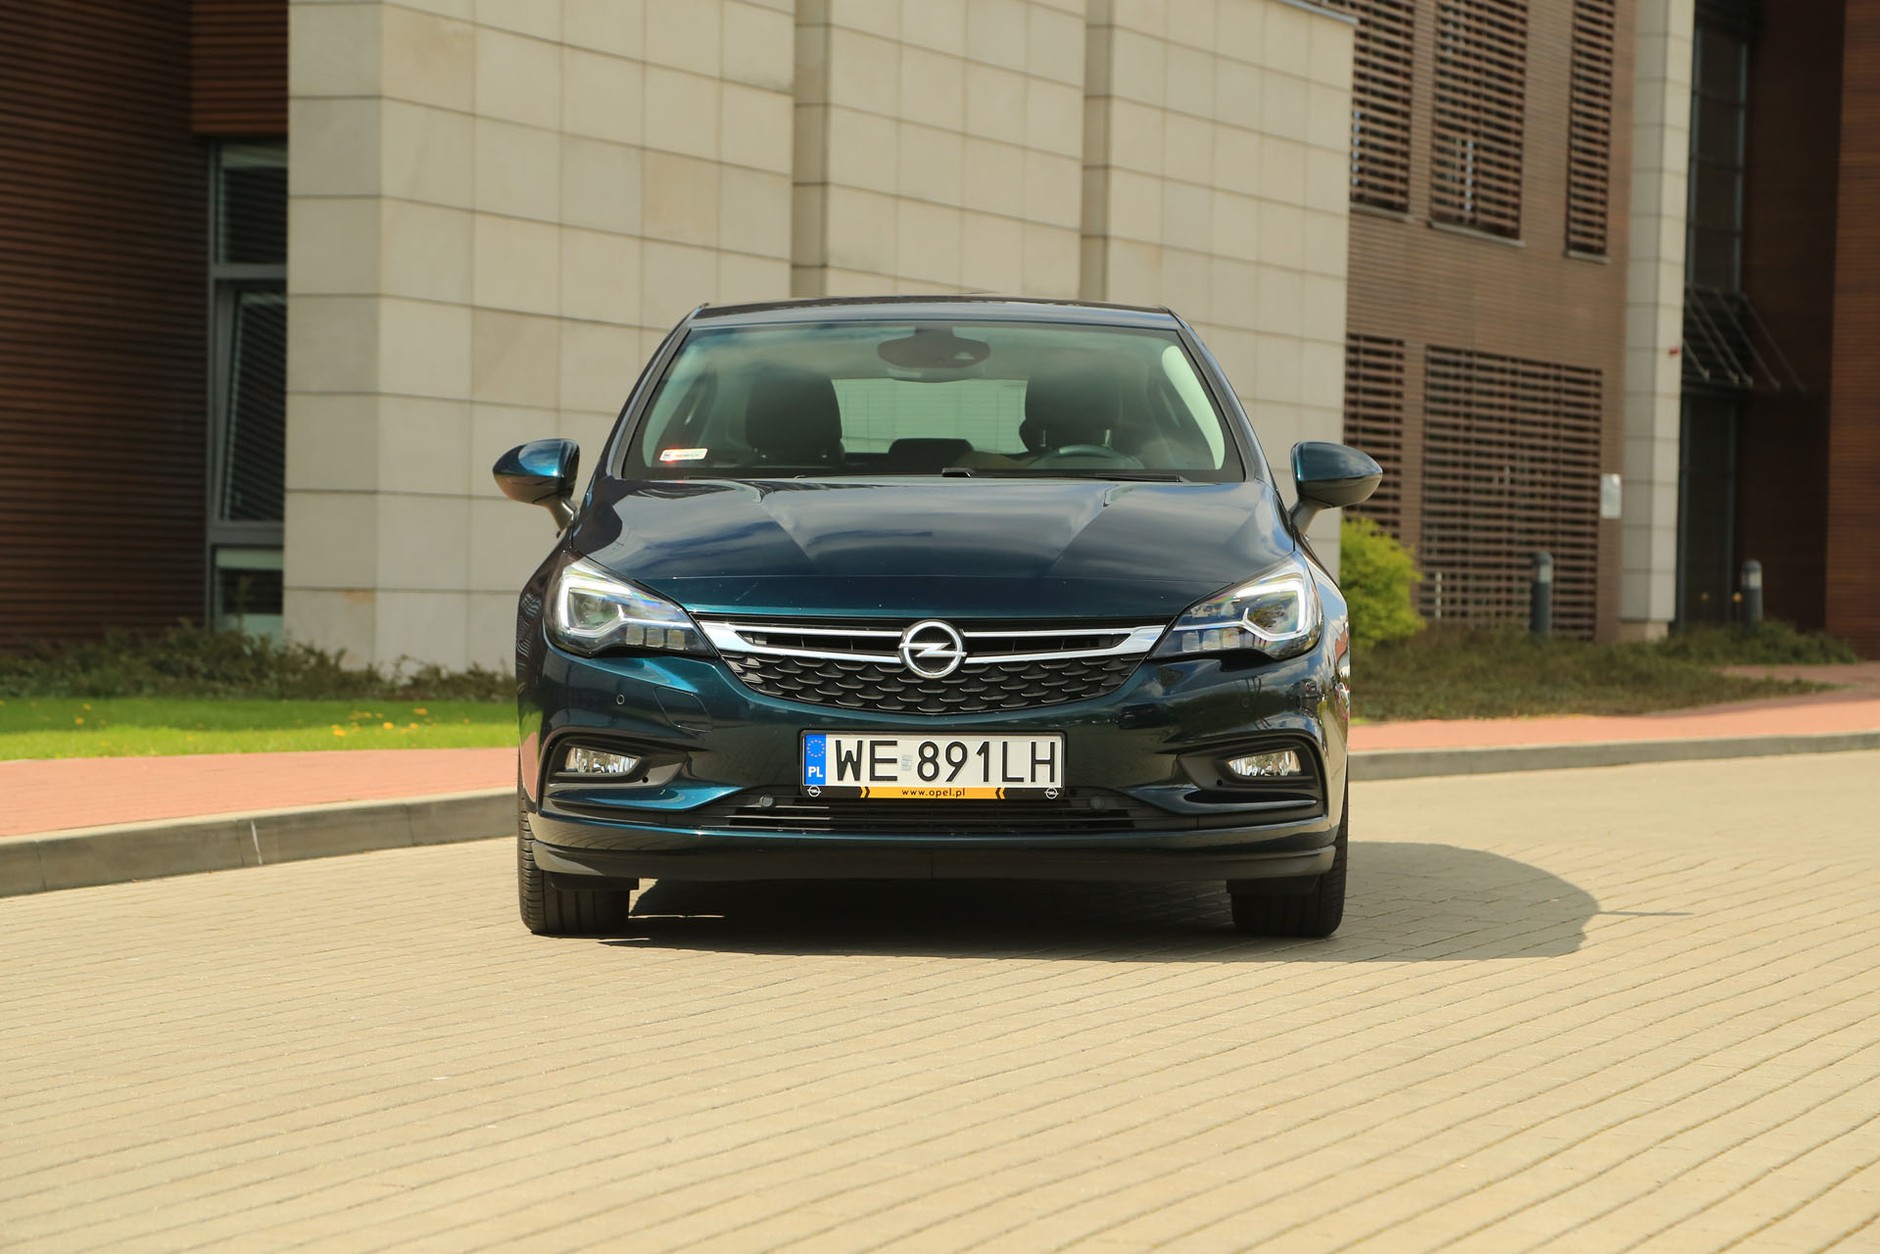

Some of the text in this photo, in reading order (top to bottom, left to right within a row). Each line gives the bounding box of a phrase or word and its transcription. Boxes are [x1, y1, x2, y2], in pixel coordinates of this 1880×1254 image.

[835, 740, 1055, 783] WE 891LH
[808, 766, 823, 778] PL
[902, 788, 966, 797] www.opel.pl
